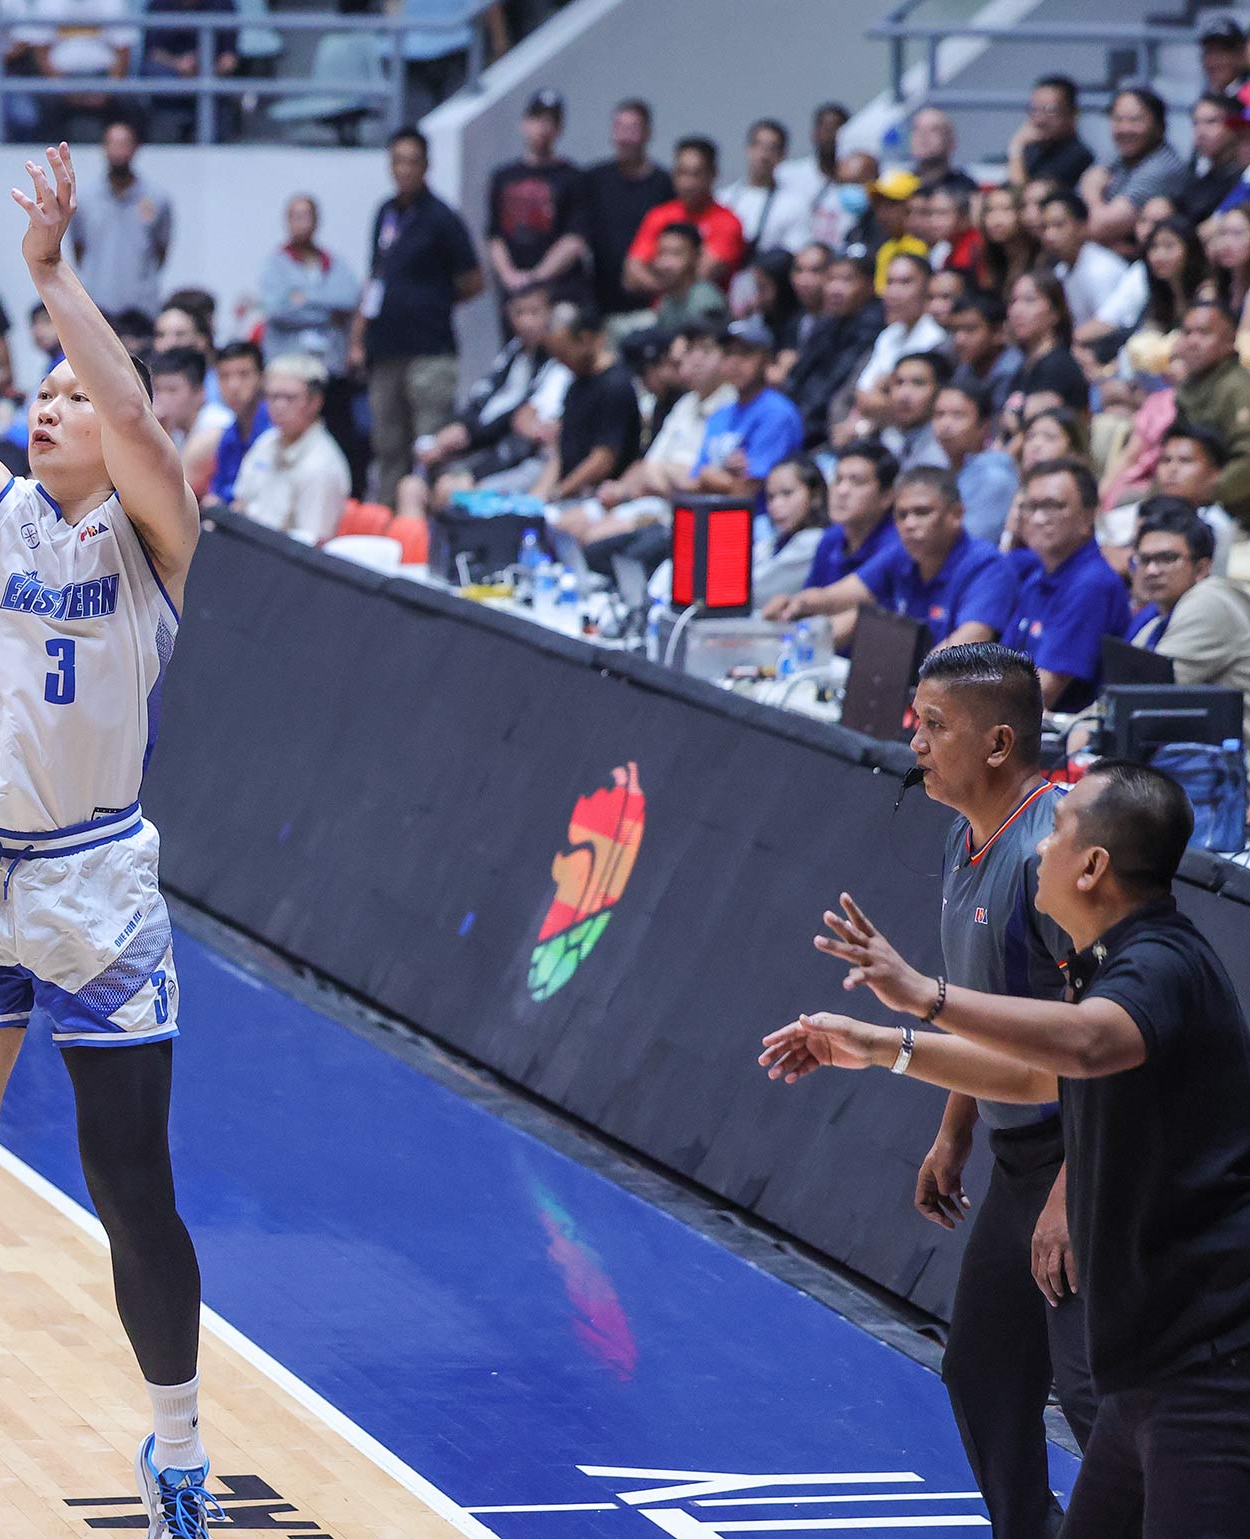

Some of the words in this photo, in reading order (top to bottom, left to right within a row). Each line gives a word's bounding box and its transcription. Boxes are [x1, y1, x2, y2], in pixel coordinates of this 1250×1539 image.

[0, 569, 120, 622] EASTERN
[44, 637, 77, 705] 3
[150, 969, 169, 1025] 3
